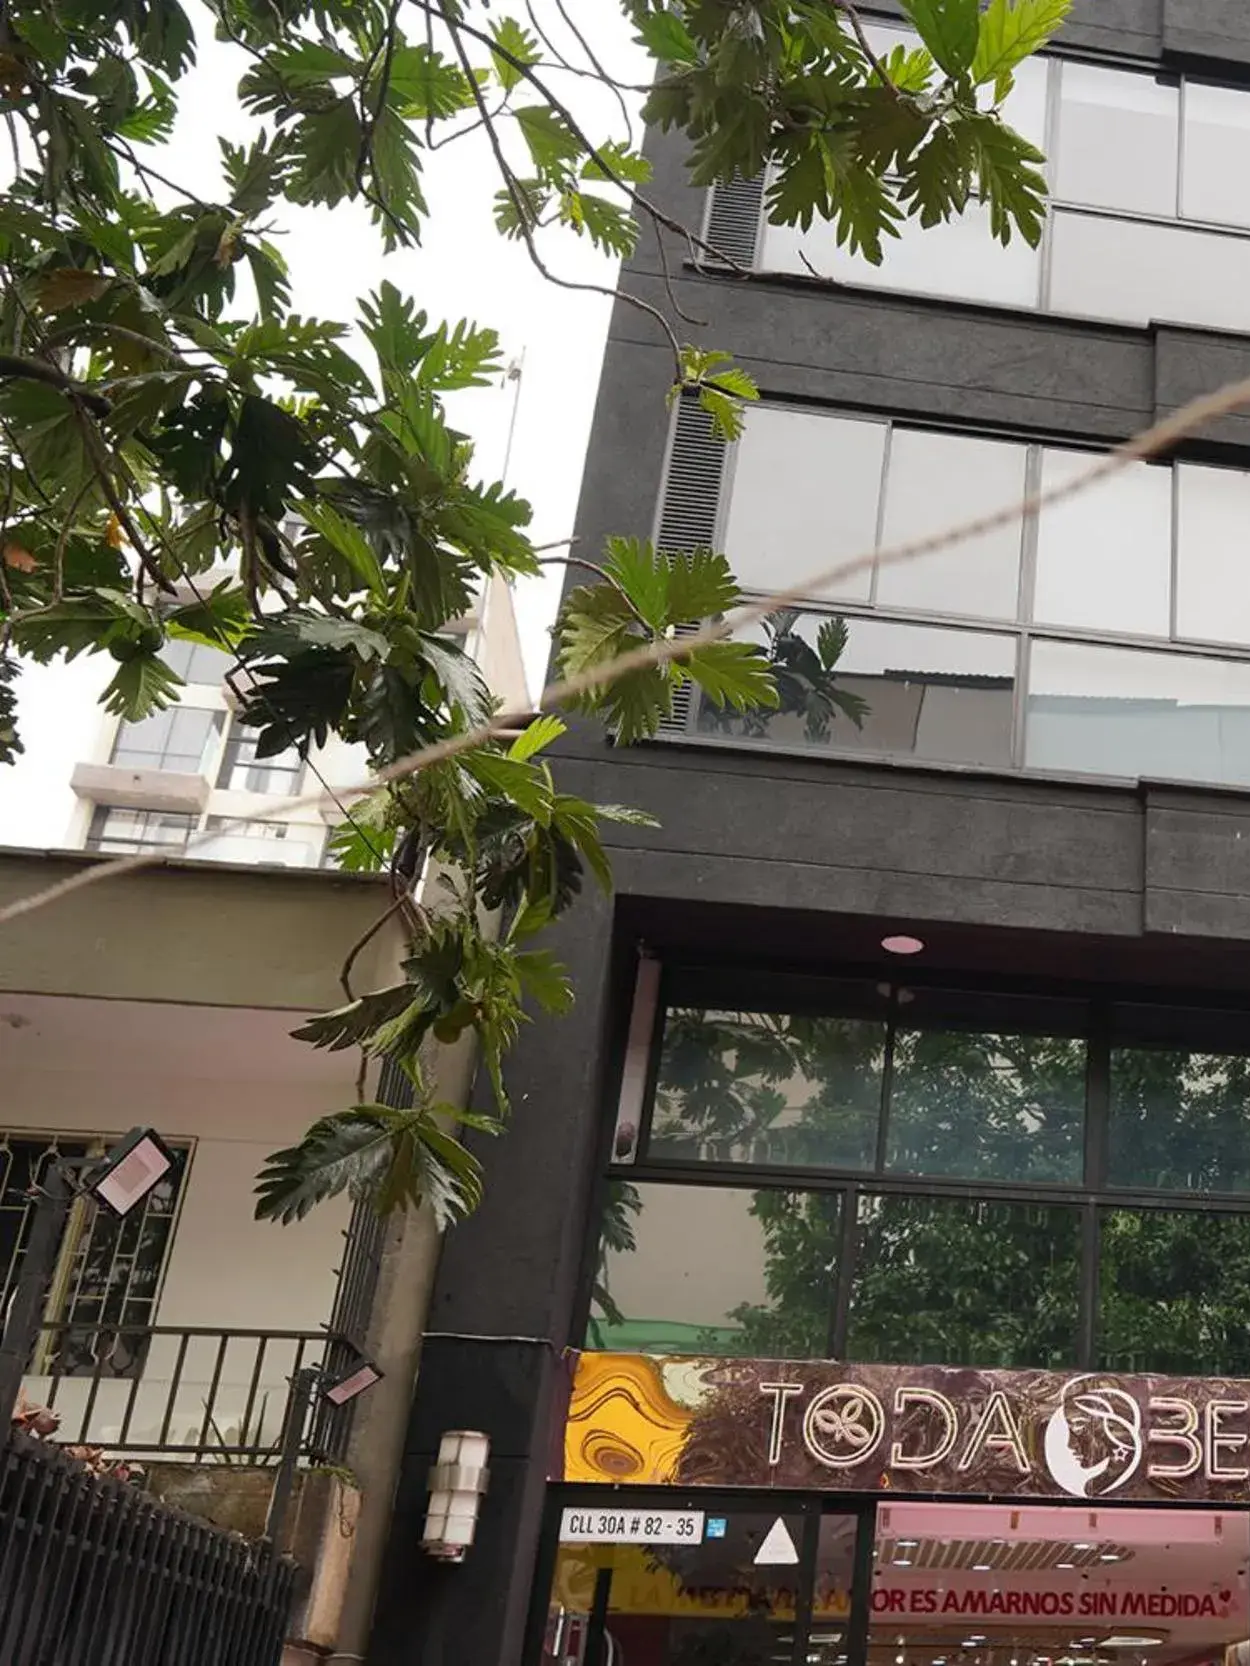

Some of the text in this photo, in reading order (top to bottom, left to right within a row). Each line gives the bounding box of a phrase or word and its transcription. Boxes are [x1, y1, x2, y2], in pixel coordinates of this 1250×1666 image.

[759, 1382, 1032, 1474] TODA
[569, 1514, 594, 1535] CLL
[597, 1515, 627, 1536] 30A
[629, 1517, 642, 1537] #
[643, 1516, 664, 1537] 82
[675, 1518, 696, 1538] 35
[910, 1589, 937, 1612] ES
[941, 1589, 1075, 1615] AMARNOS
[1078, 1592, 1117, 1617] SIN
[1120, 1592, 1218, 1617] MEDIDA
